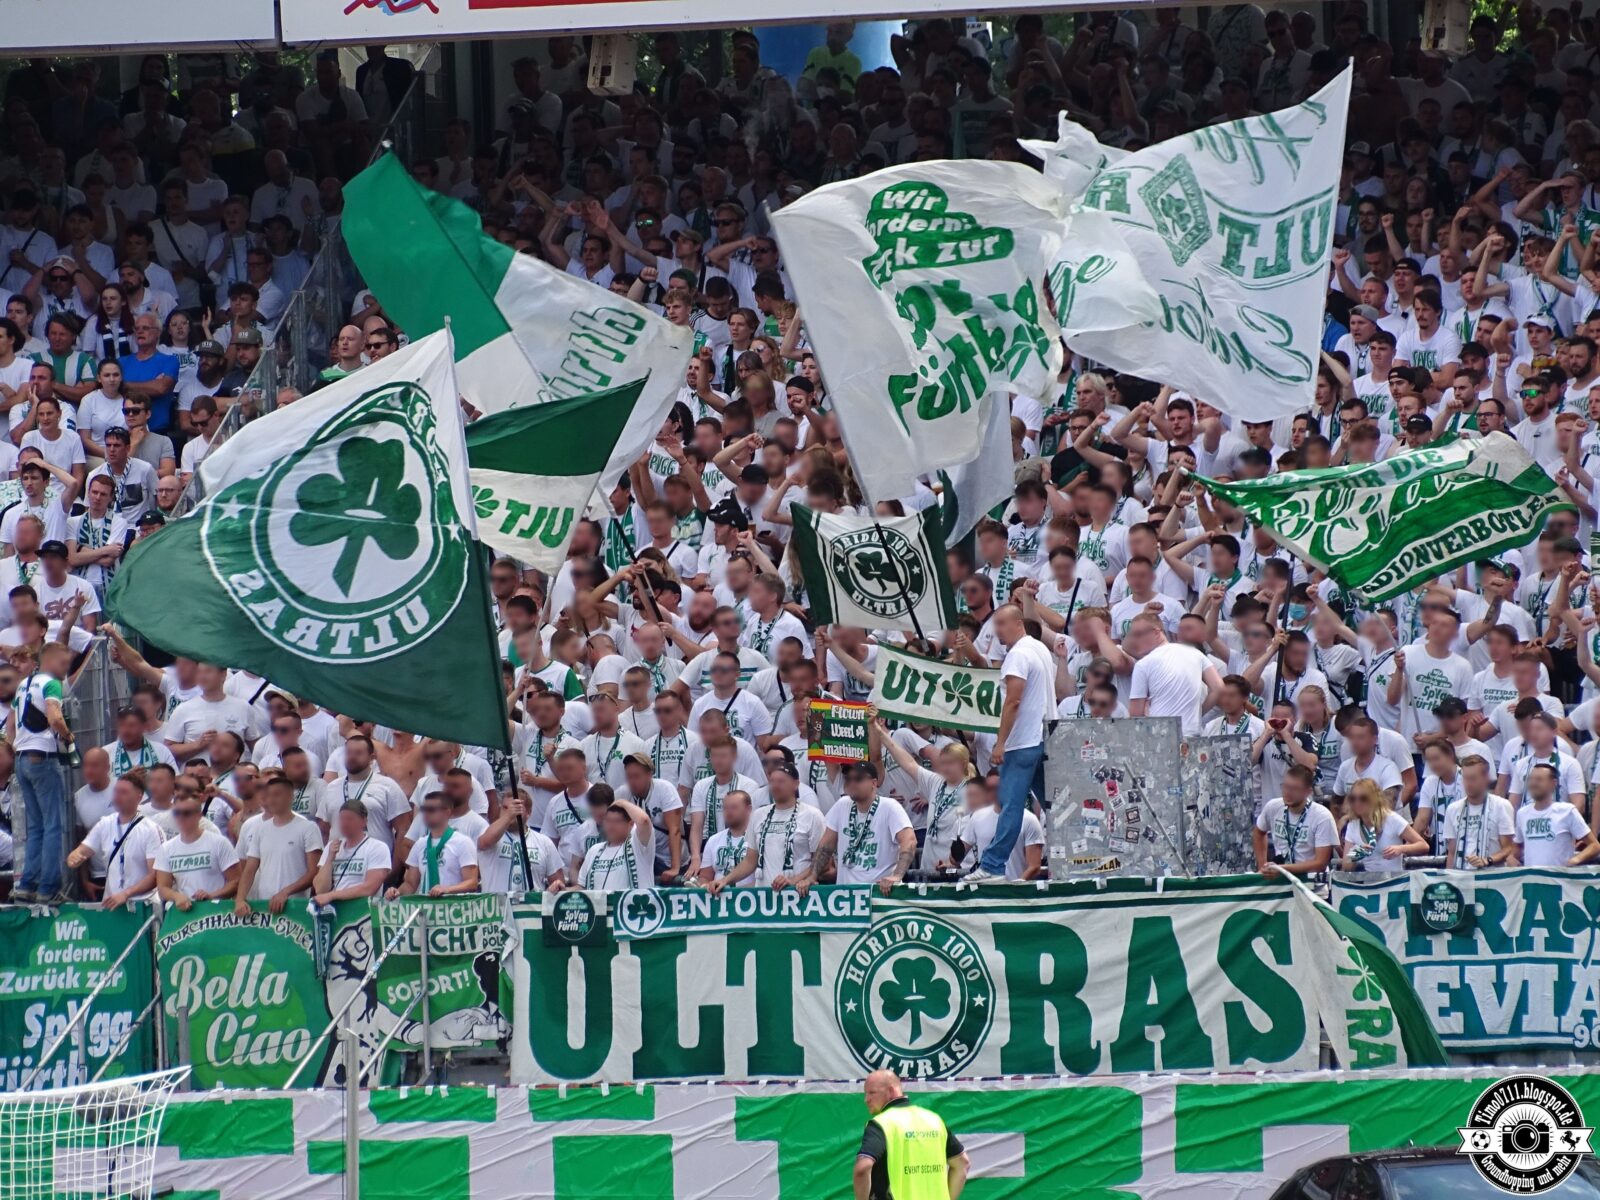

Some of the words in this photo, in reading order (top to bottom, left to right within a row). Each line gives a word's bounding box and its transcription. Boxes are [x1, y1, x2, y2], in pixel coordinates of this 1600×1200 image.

[882, 188, 942, 210] Wir
[936, 233, 1000, 264] zur
[1394, 449, 1444, 484] DIE
[881, 661, 943, 706] ULT
[831, 723, 855, 739] Weed
[823, 743, 865, 759] machines
[564, 910, 589, 923] SpVgg
[669, 889, 871, 921] ENTOURAGE
[1426, 911, 1449, 922] Fürth
[1434, 901, 1459, 914] SpVgg
[54, 920, 87, 941] Wir
[36, 943, 107, 966] fordern:
[846, 921, 935, 986] HORIDOS
[941, 934, 982, 981] 1000
[0, 966, 81, 994] Zurück
[165, 952, 290, 1018] Bella
[205, 1012, 311, 1067] Ciao
[863, 1038, 970, 1078] ULTRAS
